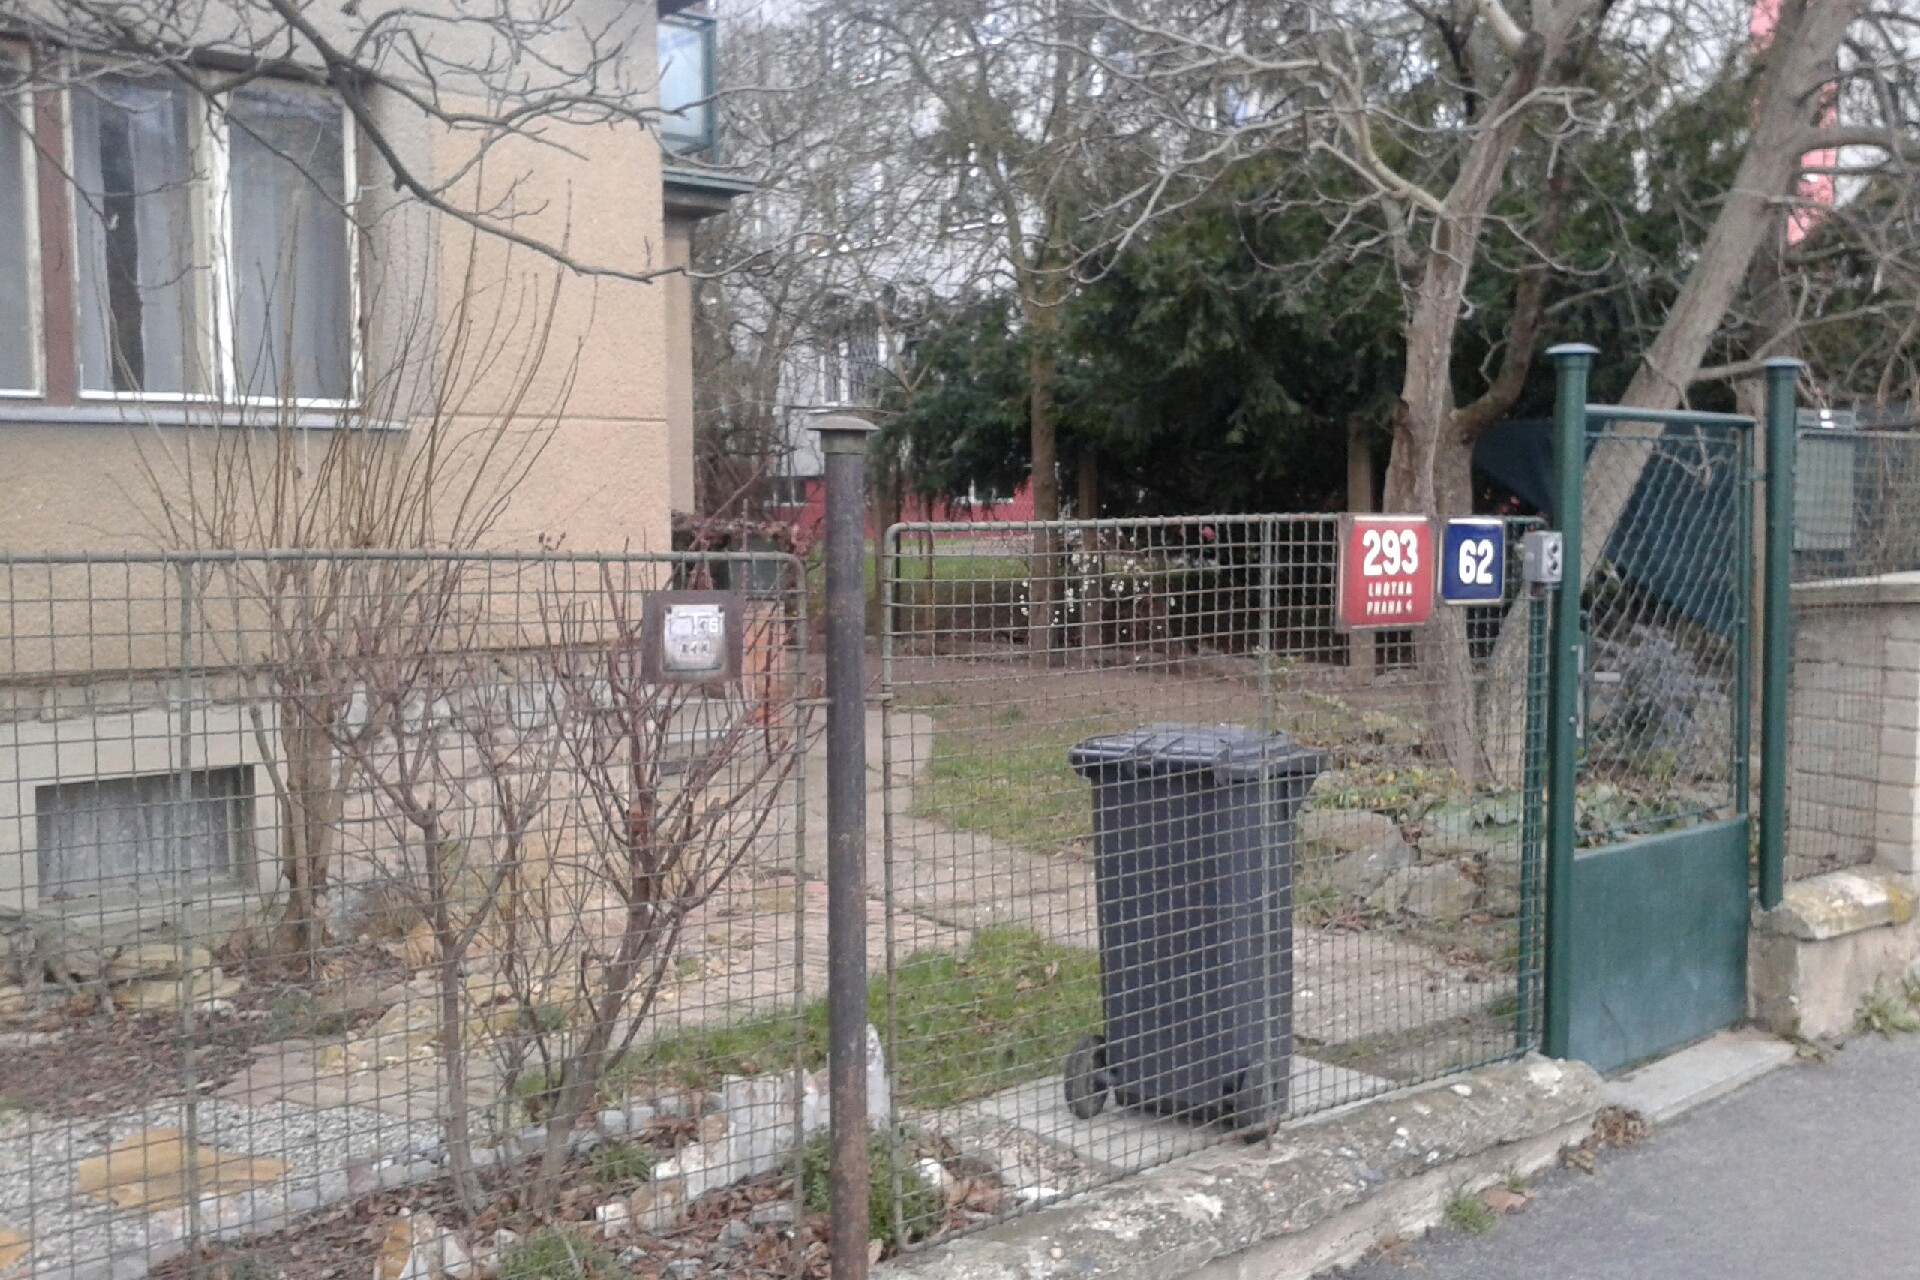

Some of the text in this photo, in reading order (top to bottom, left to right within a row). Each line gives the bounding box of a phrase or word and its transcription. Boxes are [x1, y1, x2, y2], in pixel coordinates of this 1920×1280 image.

[1362, 529, 1418, 576] 293
[1458, 539, 1493, 584] 62
[1366, 600, 1402, 615] PRAHA
